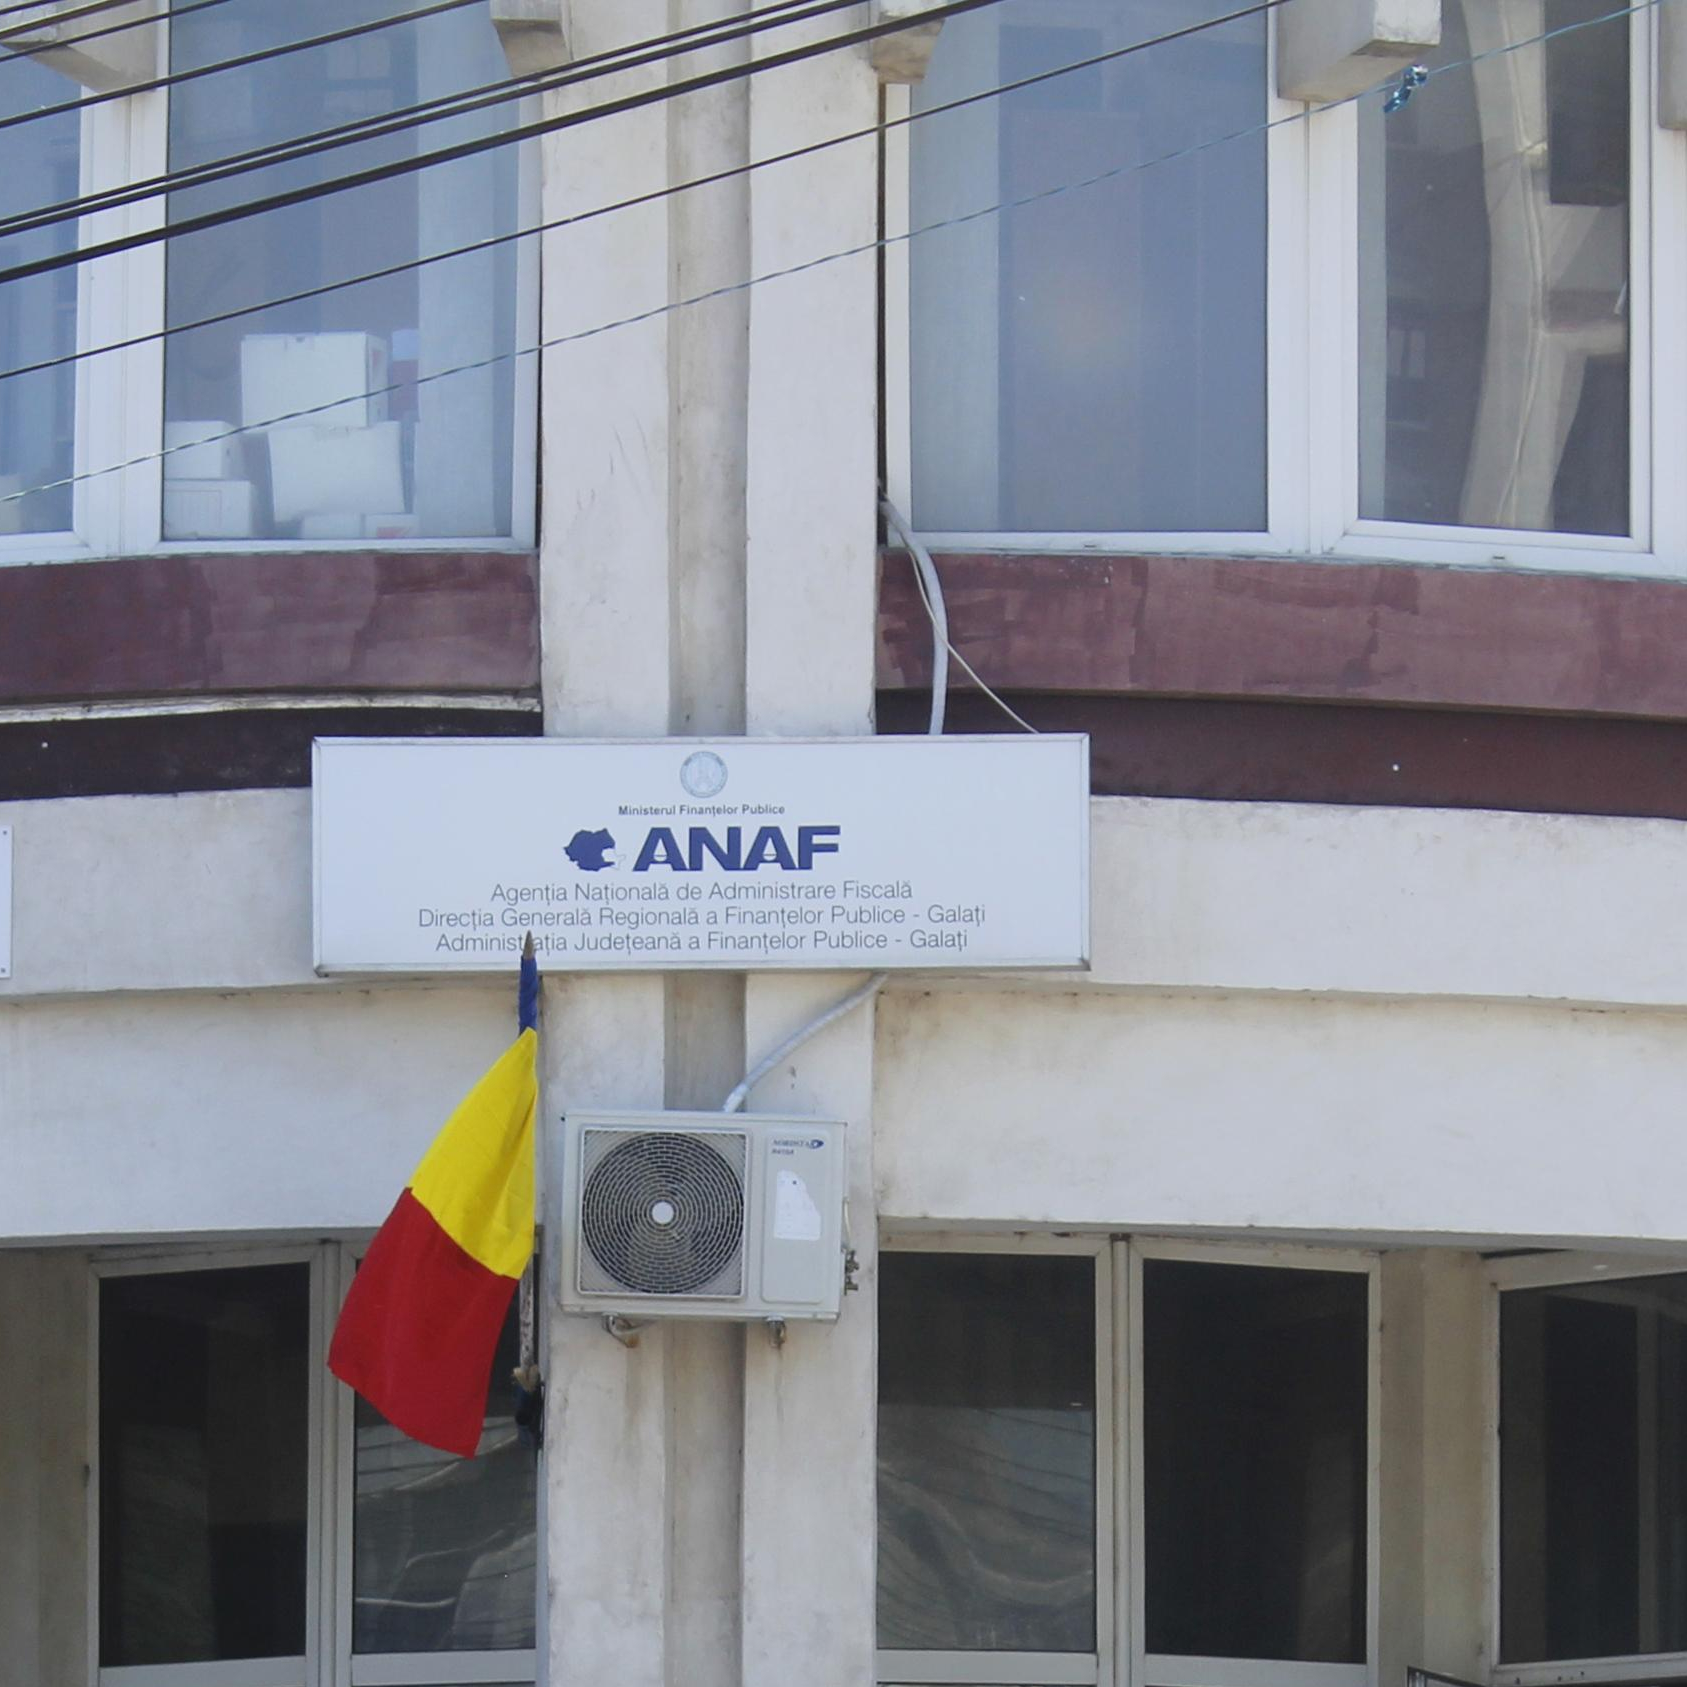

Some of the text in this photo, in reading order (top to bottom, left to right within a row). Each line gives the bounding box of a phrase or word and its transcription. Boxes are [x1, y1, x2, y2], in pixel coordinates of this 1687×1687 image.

[618, 804, 676, 816] Ministerul
[742, 803, 785, 815] Publice
[632, 825, 841, 872] ANAF
[676, 882, 703, 901] de
[708, 881, 836, 900] Administrare
[843, 879, 913, 900] Fiscală
[500, 907, 592, 928] Generală
[599, 906, 700, 930] Regională
[705, 910, 719, 926] a
[831, 904, 906, 925] Publice
[687, 936, 701, 951] a
[813, 929, 888, 950] Publice
